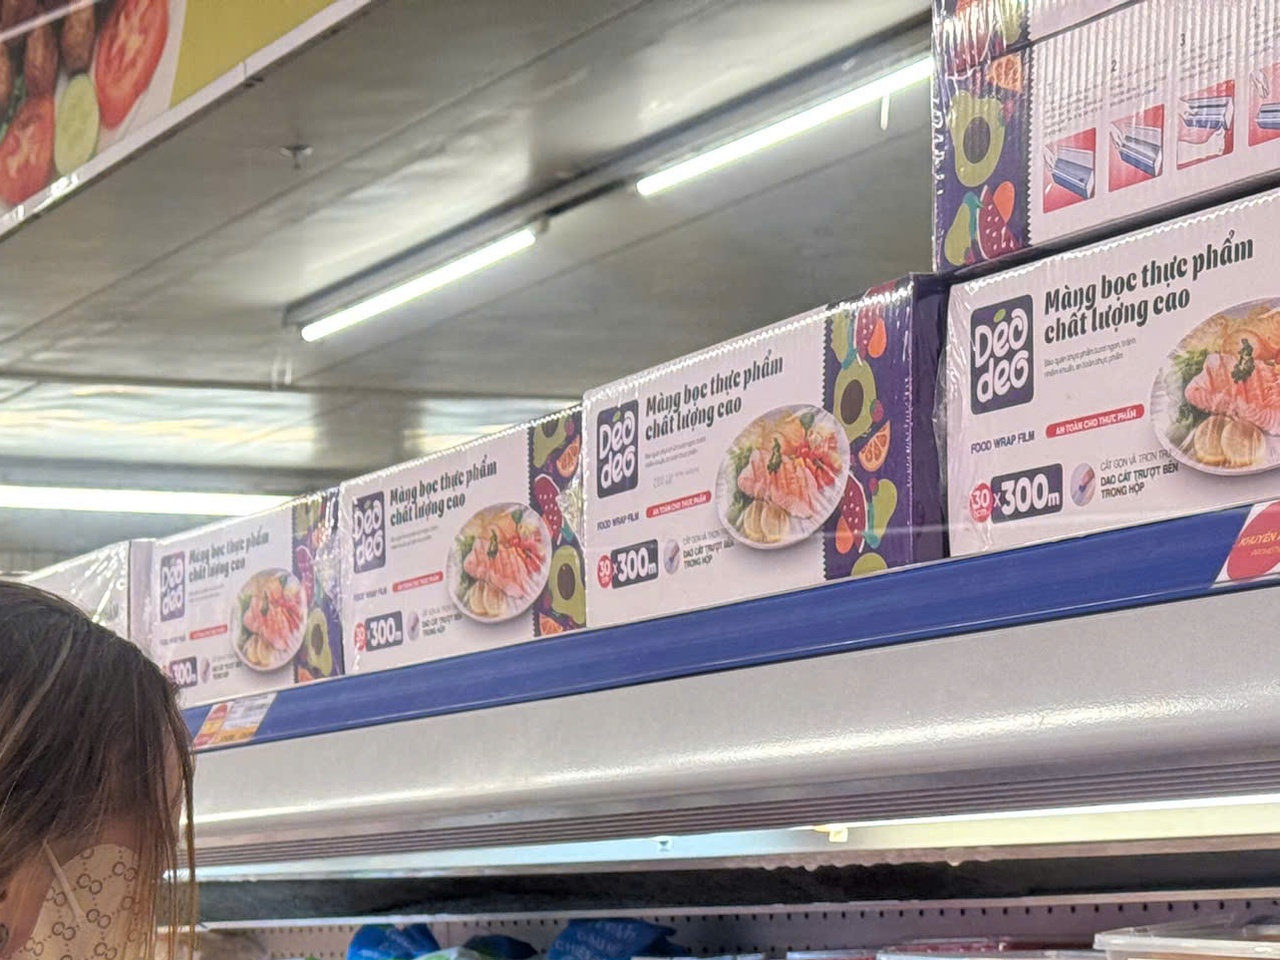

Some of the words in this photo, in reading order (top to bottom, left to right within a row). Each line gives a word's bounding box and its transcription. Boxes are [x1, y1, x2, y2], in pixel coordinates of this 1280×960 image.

[1101, 272, 1138, 301] bọc
[1142, 255, 1188, 288] thực
[1192, 229, 1254, 281] phẩm
[1044, 308, 1088, 344] chất
[1092, 300, 1148, 332] lượng
[1153, 288, 1191, 316] cao
[684, 383, 708, 406] bọc
[710, 370, 741, 396] thực
[677, 404, 715, 432] lượng
[717, 396, 742, 419] cao
[971, 440, 992, 454] FOOD
[993, 434, 1016, 448] WRAP
[1018, 430, 1035, 443] FILM
